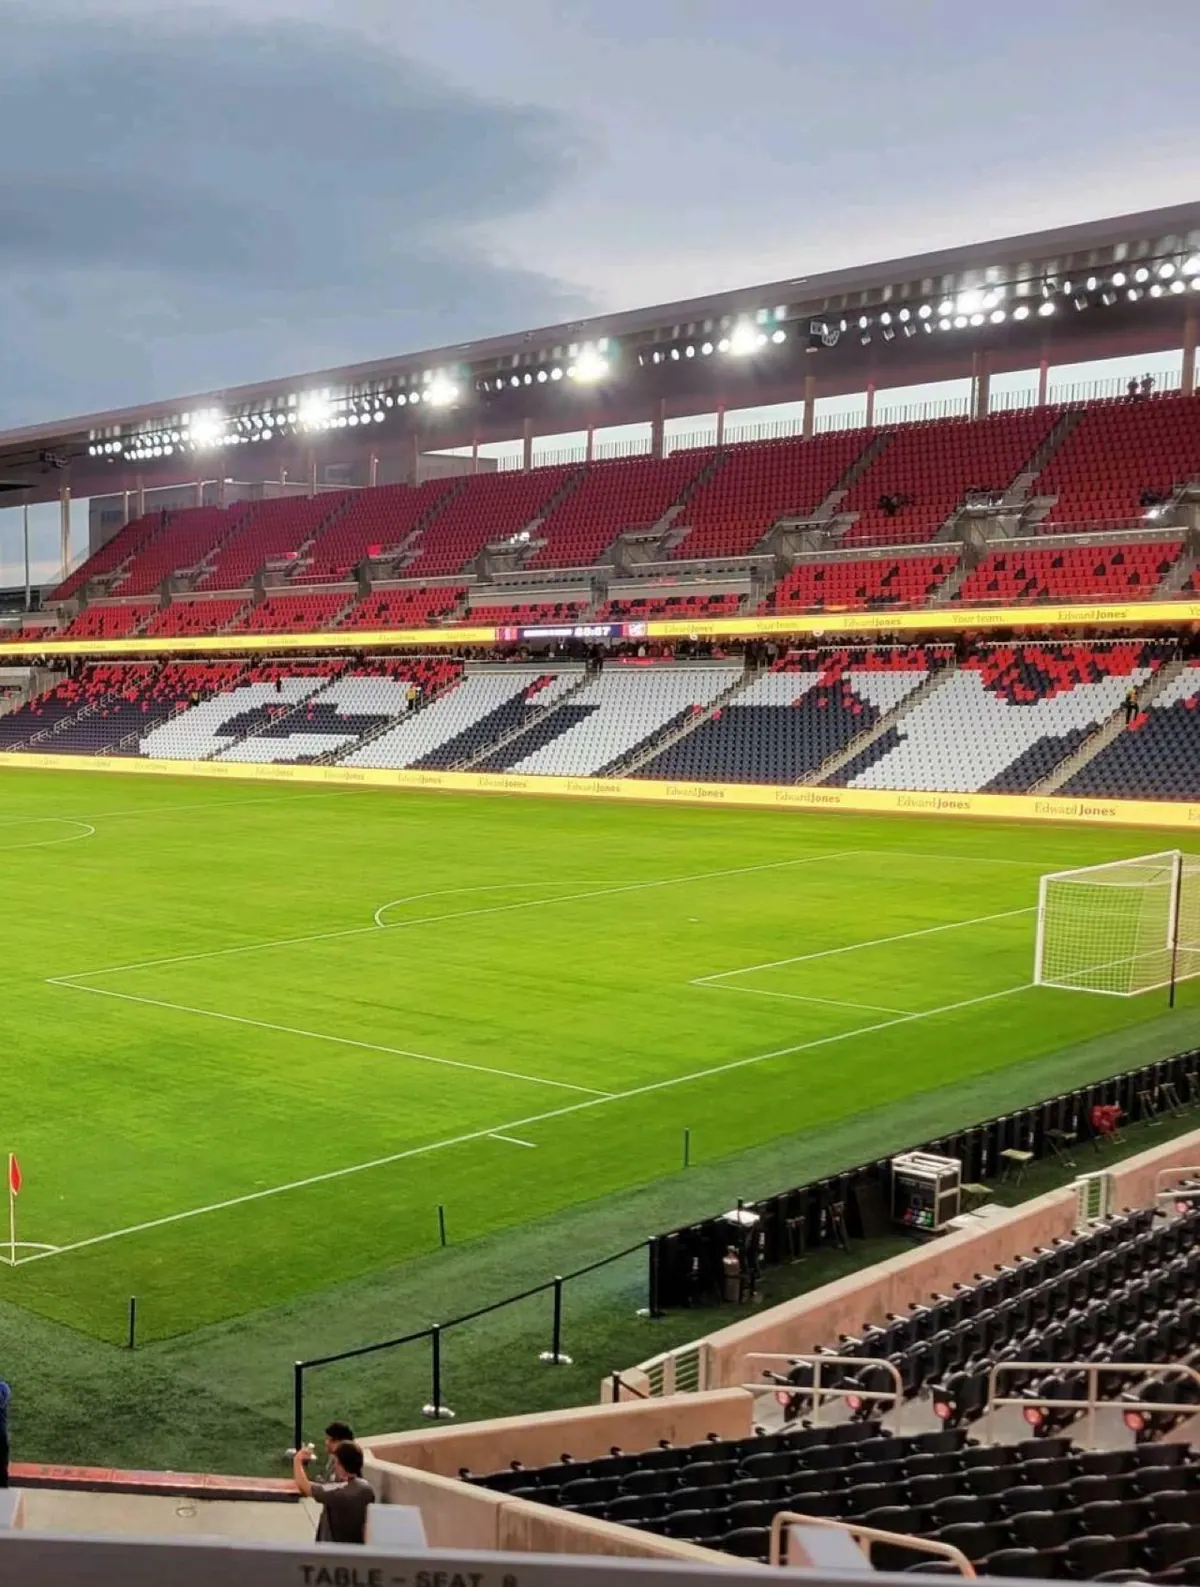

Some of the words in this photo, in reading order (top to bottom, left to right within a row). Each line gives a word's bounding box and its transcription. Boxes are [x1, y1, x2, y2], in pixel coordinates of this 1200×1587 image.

[1078, 804, 1116, 817] Jones
[300, 1564, 383, 1586] TABLE
[415, 1570, 484, 1587] SEAT
